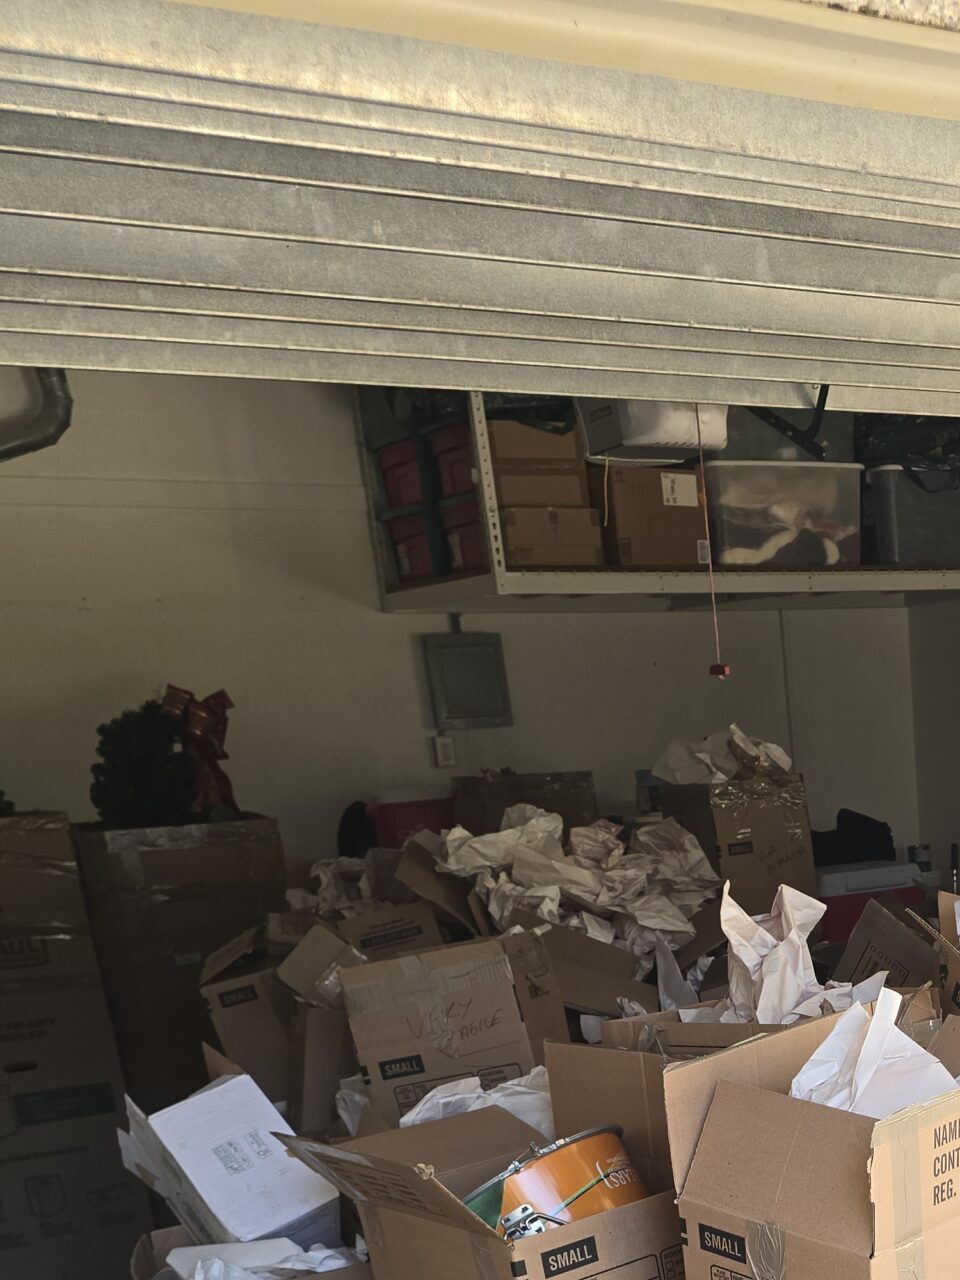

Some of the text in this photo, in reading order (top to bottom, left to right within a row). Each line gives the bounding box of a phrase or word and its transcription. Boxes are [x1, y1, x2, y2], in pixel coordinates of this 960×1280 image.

[384, 1060, 420, 1077] SMALL
[933, 1179, 956, 1206] REG.
[704, 1231, 742, 1257] SMALL
[548, 1245, 592, 1271] SMALL
